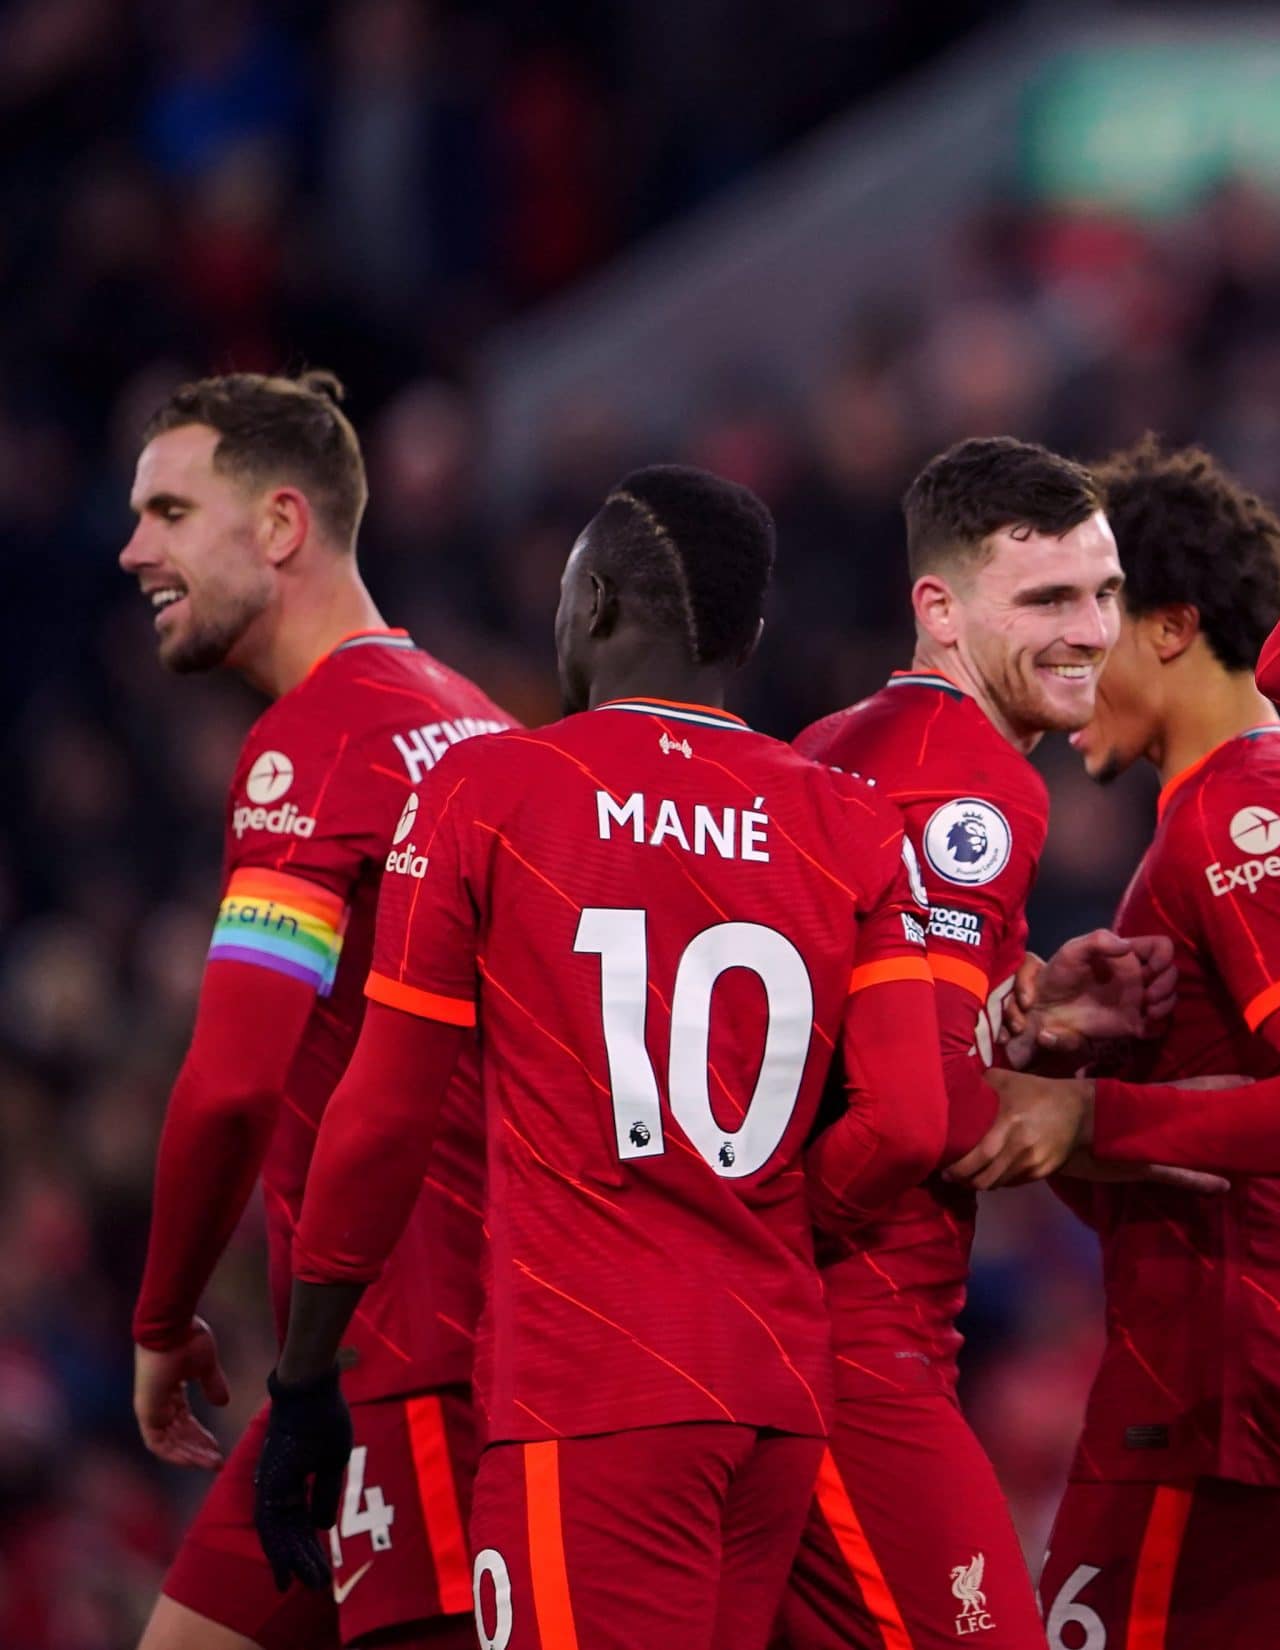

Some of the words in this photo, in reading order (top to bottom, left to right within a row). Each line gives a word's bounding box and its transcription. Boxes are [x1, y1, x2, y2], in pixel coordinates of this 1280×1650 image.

[596, 790, 769, 863] MANÉ
[930, 907, 978, 930] room
[573, 907, 814, 1178] 10
